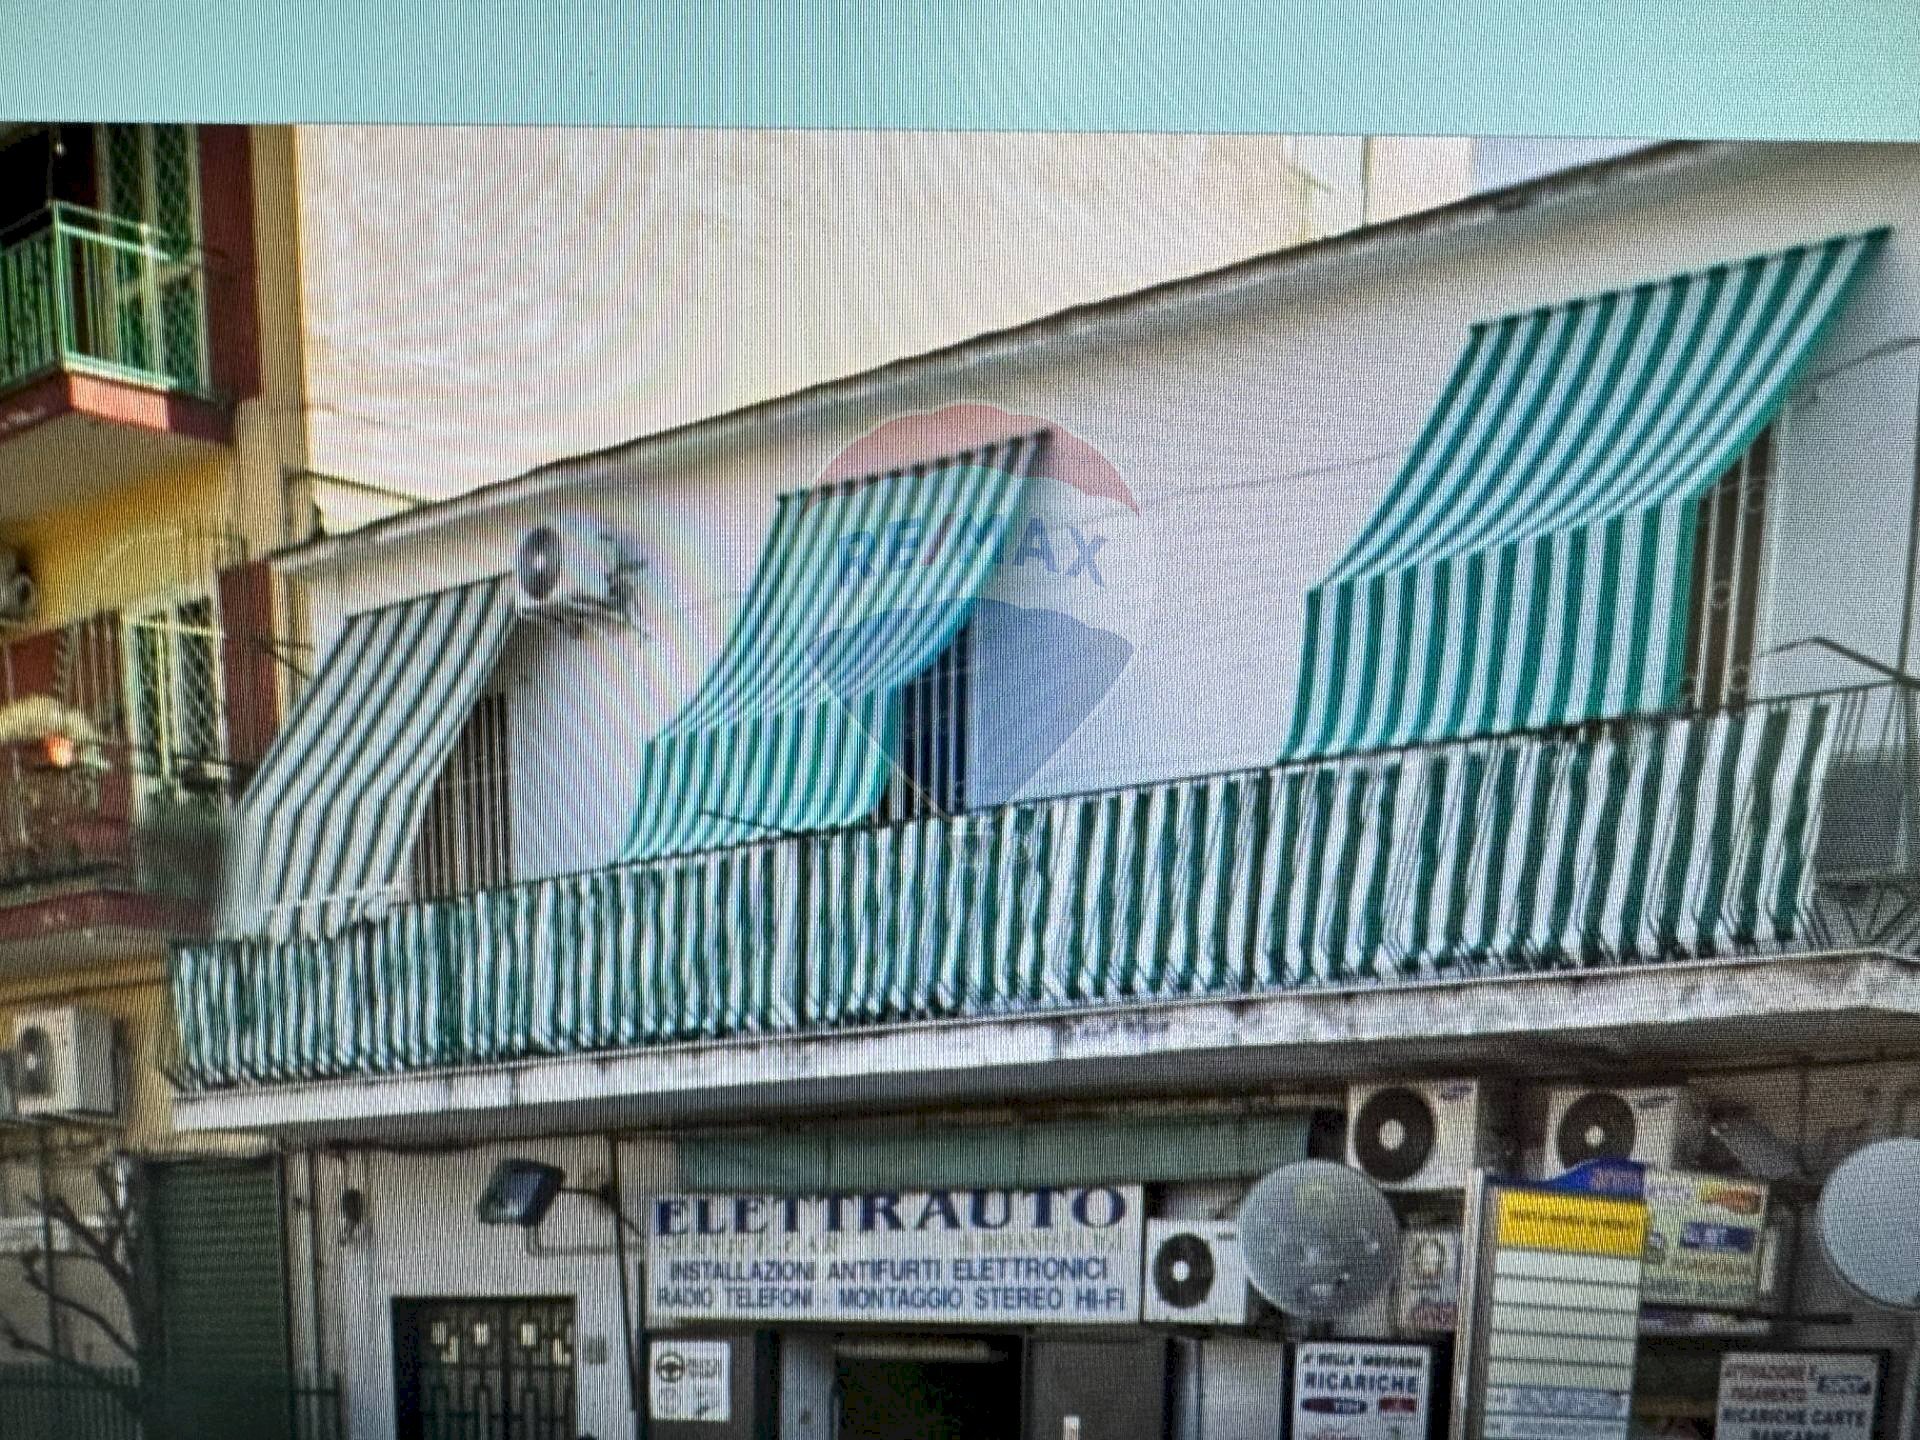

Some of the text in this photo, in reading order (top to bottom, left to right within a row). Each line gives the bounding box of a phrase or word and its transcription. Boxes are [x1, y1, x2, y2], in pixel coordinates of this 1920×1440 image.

[656, 1187, 1128, 1235] ELETTRAUTO
[669, 1256, 1108, 1282] INSTALLAZIONI ANTIFURTI ELETTRONICI
[657, 1286, 713, 1308] RADIO
[724, 1286, 813, 1309] TELEFONI
[837, 1286, 963, 1310] MONTAGGIO
[974, 1286, 1064, 1312] STEREO
[1304, 1371, 1419, 1394] RICARICHE
[1722, 1406, 1806, 1425] RICARICHE
